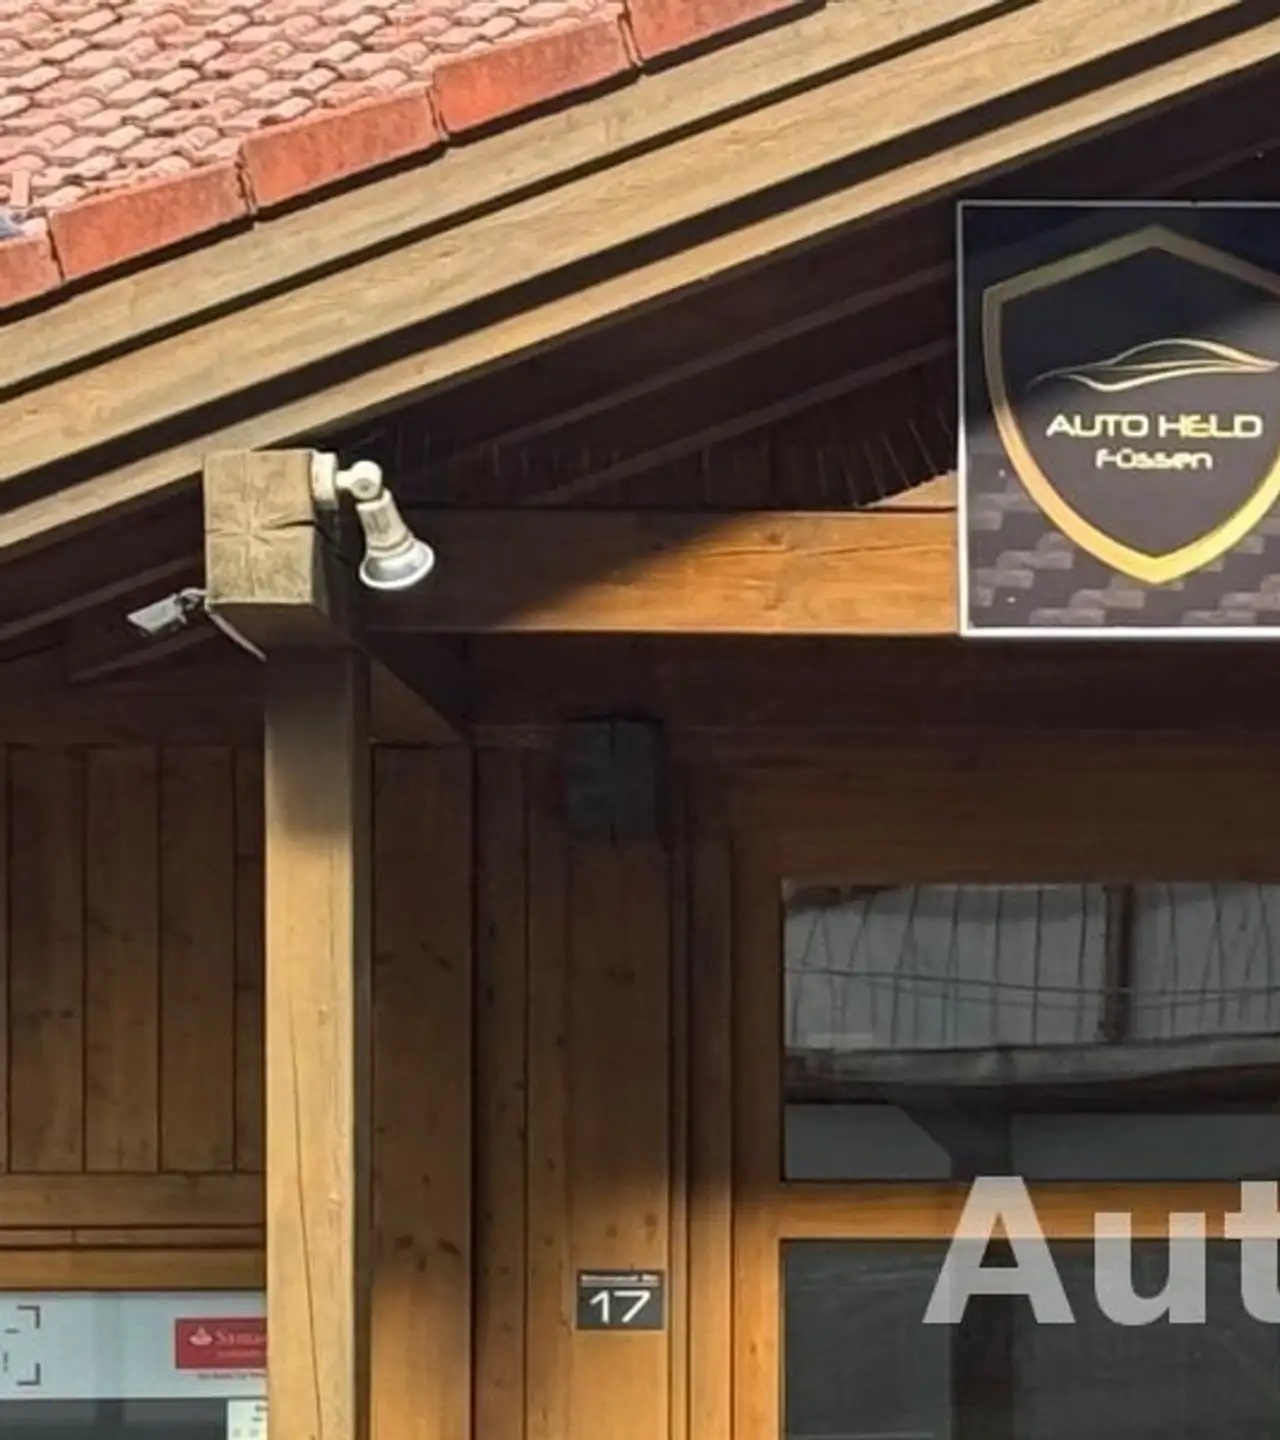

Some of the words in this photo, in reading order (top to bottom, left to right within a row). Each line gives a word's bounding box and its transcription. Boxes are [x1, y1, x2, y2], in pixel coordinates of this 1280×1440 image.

[1045, 413, 1149, 438] AUTO
[1157, 413, 1264, 439] HELD
[1095, 447, 1214, 470] Füssen
[588, 1289, 652, 1324] 17
